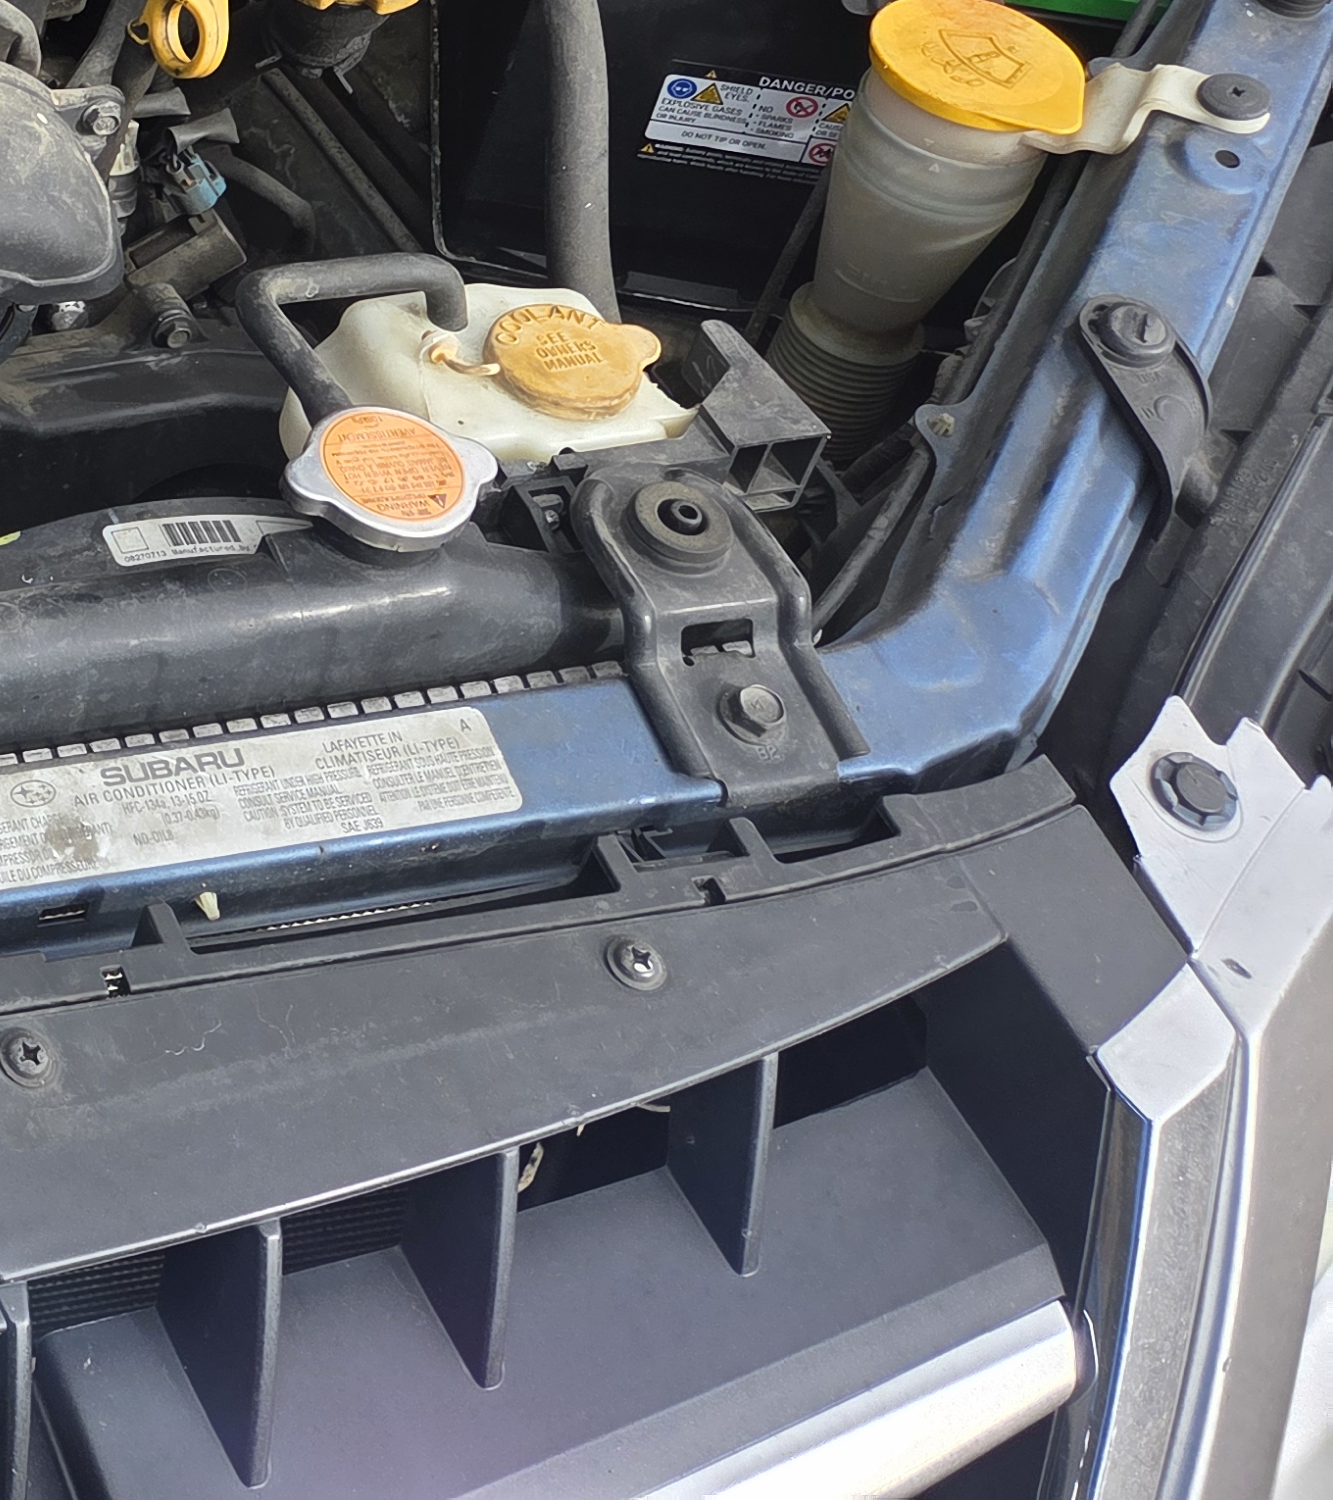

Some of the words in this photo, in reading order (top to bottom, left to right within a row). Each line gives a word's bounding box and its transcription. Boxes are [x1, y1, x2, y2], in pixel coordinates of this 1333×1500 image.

[719, 83, 754, 95] SHIELD
[757, 76, 856, 100] DANGER/PO
[657, 105, 676, 113] CAN
[675, 108, 703, 117] CAUSE
[660, 97, 709, 111] EXPLOSIVE
[711, 104, 743, 116] GASES
[758, 104, 774, 113] NO
[667, 114, 697, 123] INJURY
[757, 120, 792, 131] FLAMES
[759, 113, 793, 124] SPARKS
[679, 130, 695, 139] DO
[693, 132, 713, 142] NOT
[712, 135, 728, 144] TIP
[727, 137, 741, 146] OR
[754, 127, 794, 138] SMOKING
[494, 305, 605, 346] COOLANT
[536, 331, 569, 346] SEE
[535, 340, 597, 359] OWNERS
[543, 354, 603, 372] MANUAL
[376, 499, 431, 512] WARNING
[171, 544, 235, 556] Manufactured
[457, 718, 471, 732] A
[321, 732, 387, 754] LAFAYETTE
[386, 729, 403, 743] IN
[313, 745, 401, 771] CLIMATISEUR
[401, 735, 460, 756] (LI-TYPE)
[432, 750, 460, 765] HAUTE
[100, 748, 245, 787] SUBARU
[71, 791, 100, 808] AIR
[103, 774, 206, 803] CONDITIONER
[210, 764, 276, 789] (LI-TYPE)
[232, 779, 280, 797] REFRIGERANT
[280, 774, 306, 789] UNDER
[371, 772, 415, 790] CONSULTER
[412, 771, 425, 783] LE
[422, 765, 456, 781] MANUEL
[169, 791, 196, 807] 13-15
[237, 793, 274, 810] CONSULT
[273, 788, 307, 804] SERVICE
[279, 800, 313, 816] SYSTEM
[310, 799, 324, 811] TO
[322, 797, 336, 809] BE
[334, 790, 373, 807] SERVICED
[282, 817, 296, 830] BY
[293, 811, 334, 828] QUALIFIED
[332, 803, 379, 821] PERSONNEL
[340, 820, 362, 834] SAE
[361, 816, 384, 830] J639
[16, 866, 31, 881] DU
